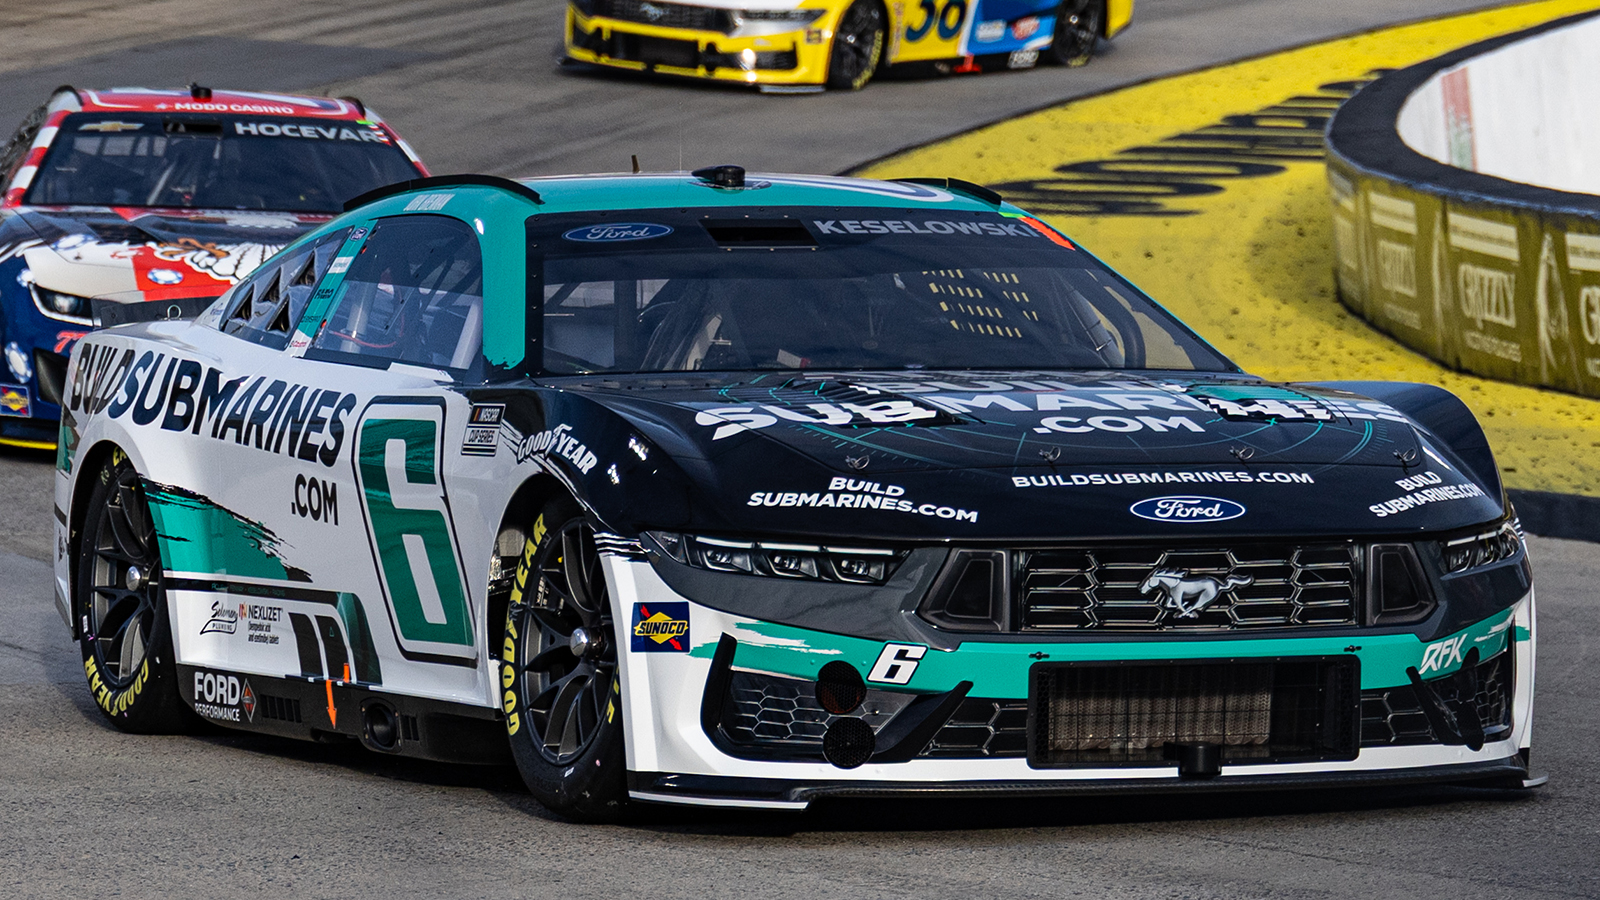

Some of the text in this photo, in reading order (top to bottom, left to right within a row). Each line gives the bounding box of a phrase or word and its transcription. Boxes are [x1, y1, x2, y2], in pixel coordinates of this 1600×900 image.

[174, 102, 294, 114] MODO CASINO
[234, 121, 381, 143] HOCEVAR
[586, 222, 651, 240] Ford
[813, 219, 1040, 238] KESELOWSKI
[70, 342, 357, 468] BUILDSUBMARINES
[479, 408, 500, 422] NASCAR
[1033, 415, 1206, 434] .COM
[828, 477, 906, 496] BUILD
[1012, 472, 1315, 487] BUILDSUBMARINES.COM
[1394, 471, 1442, 492] BUILD
[291, 473, 339, 526] .COM
[747, 492, 979, 523] SUBMARINES.COM
[1154, 499, 1225, 519] Ford
[1368, 482, 1485, 518] SUBMARINES.COM
[354, 396, 478, 668] 6
[248, 605, 283, 621] NEXLIZET
[503, 513, 548, 736] GOODYEAR
[638, 621, 686, 636] SUNOCO
[867, 642, 930, 685] 6
[1418, 633, 1468, 675] RFK
[194, 671, 241, 707] FORD
[194, 702, 241, 722] PERFORMANCE
